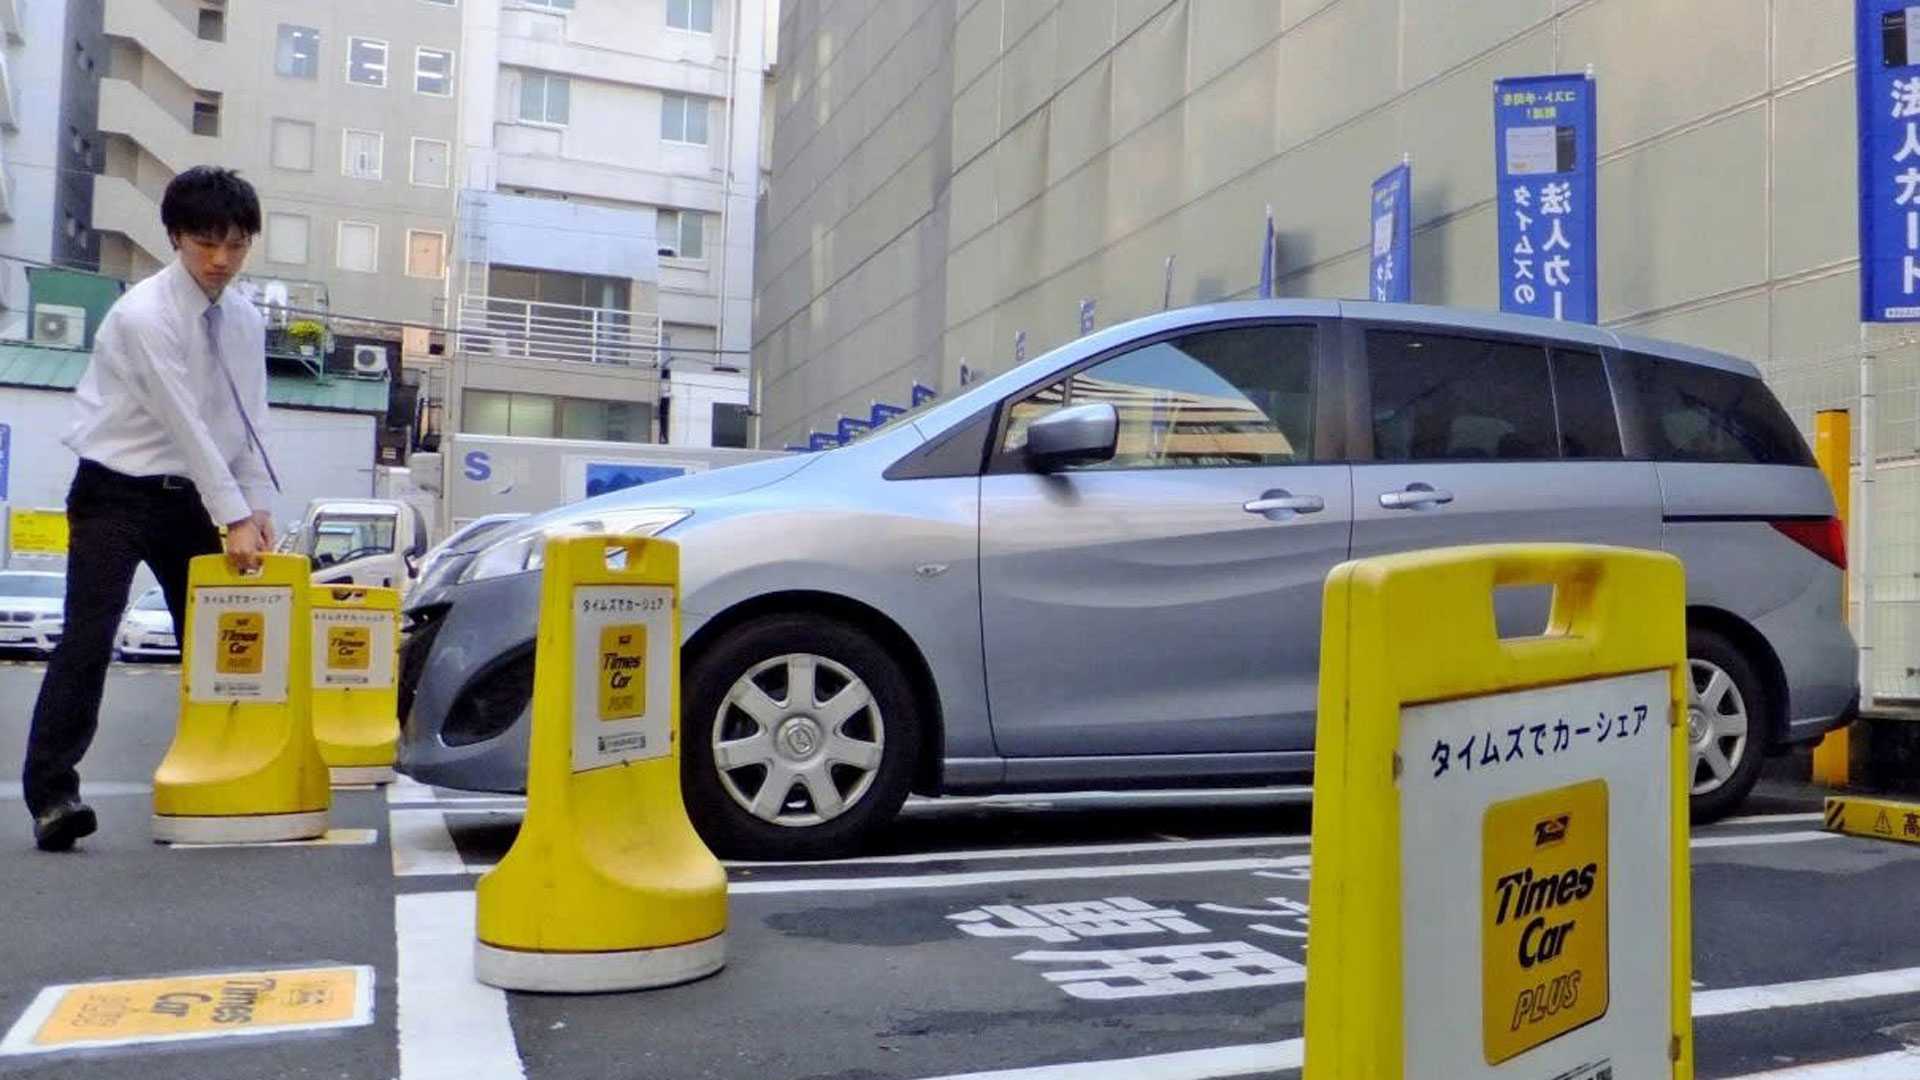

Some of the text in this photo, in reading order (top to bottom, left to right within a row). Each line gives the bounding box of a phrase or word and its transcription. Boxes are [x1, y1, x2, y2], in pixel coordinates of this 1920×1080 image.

[603, 652, 641, 671] Times
[611, 671, 632, 689] Car
[1431, 704, 1648, 778] タイムズでカーシェア
[1495, 862, 1597, 925] Times
[1518, 916, 1575, 969] Car
[1511, 969, 1582, 1032] PLUS
